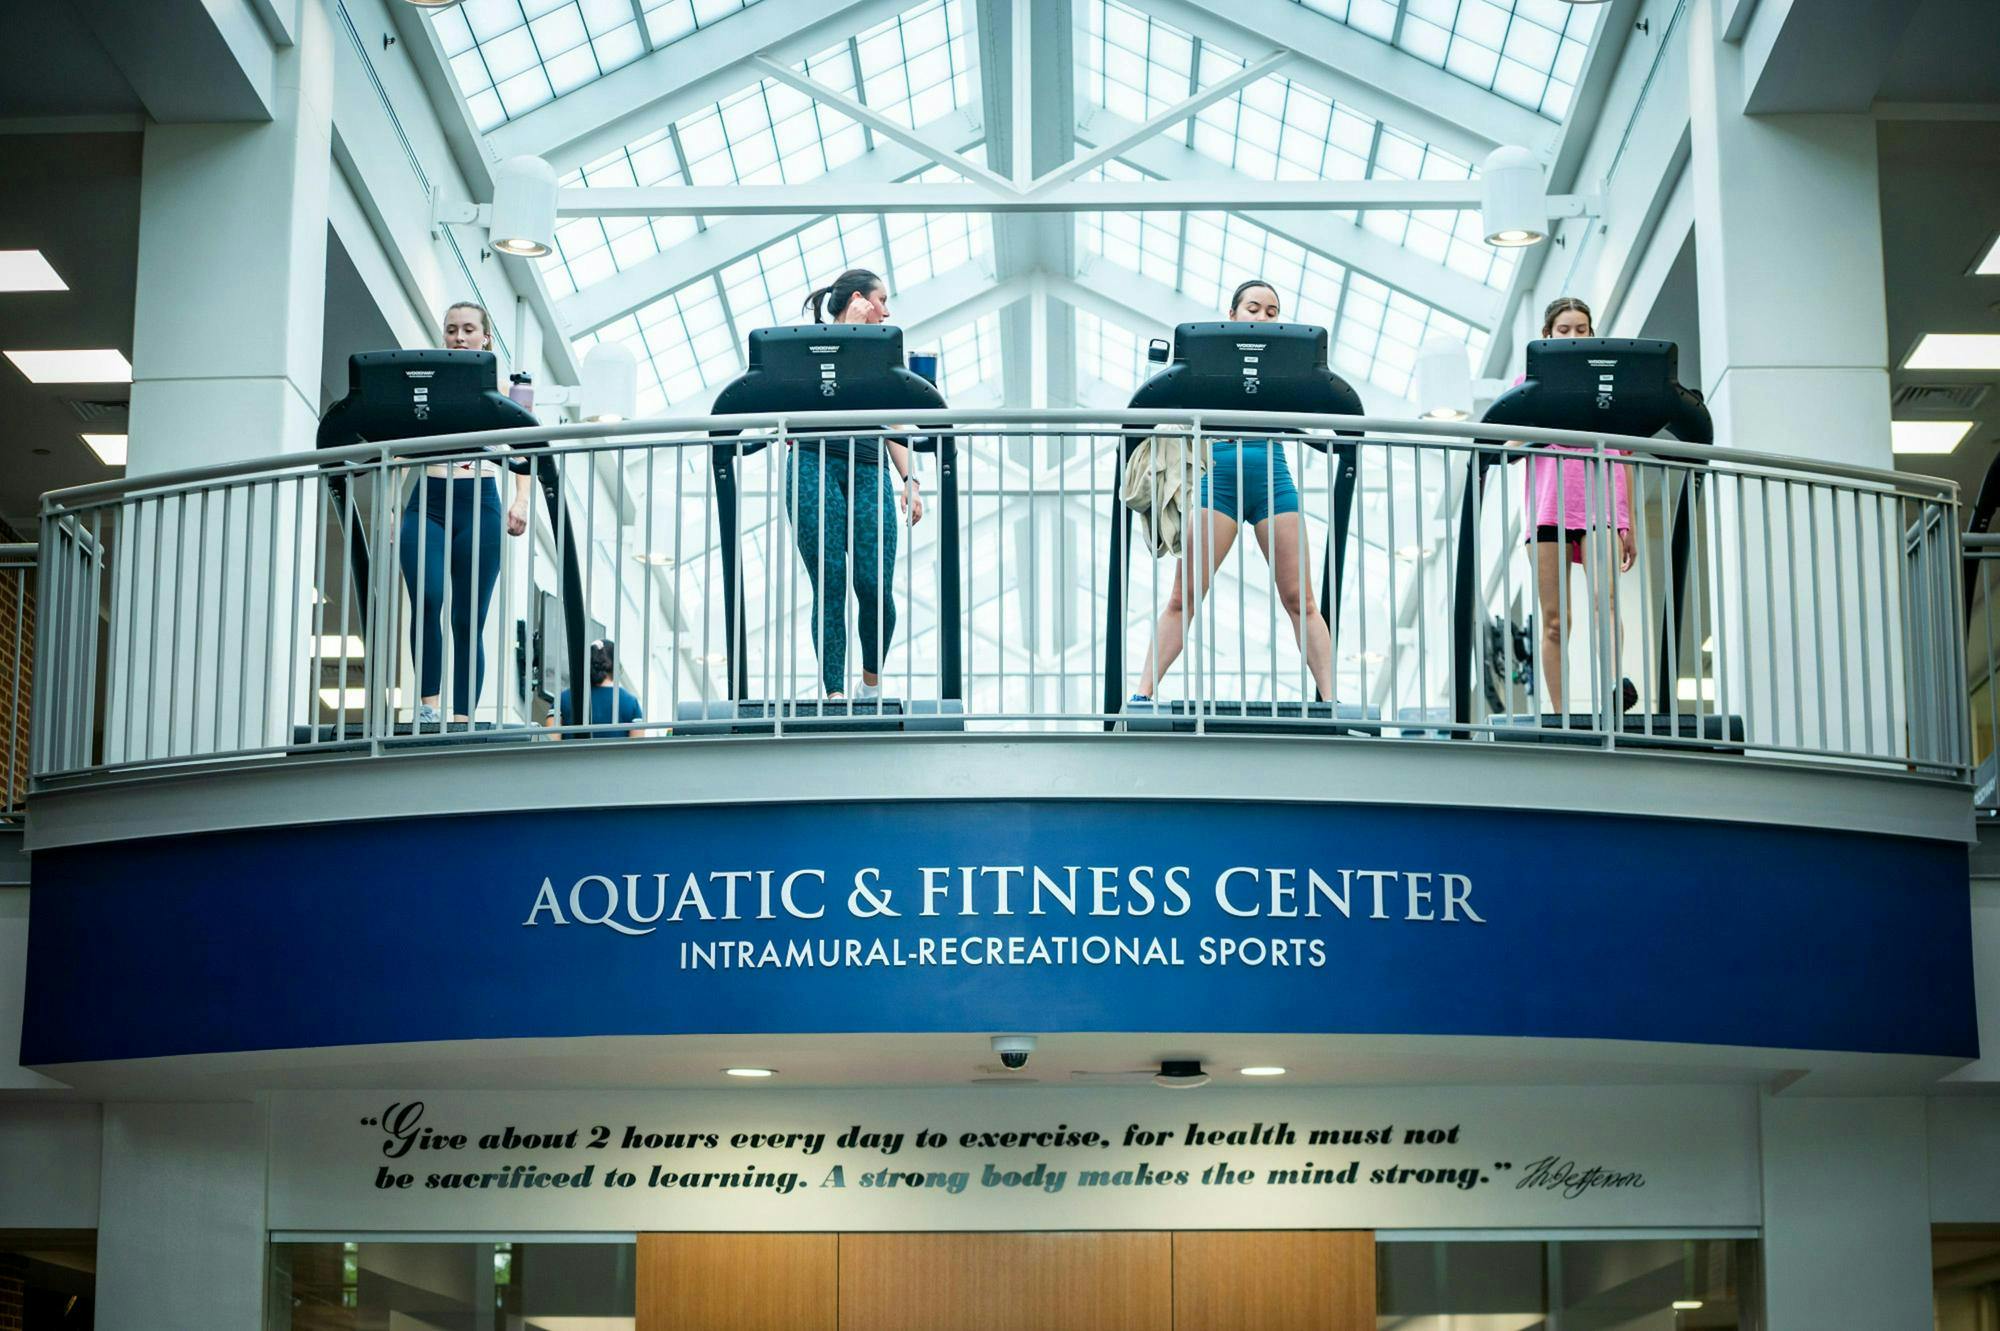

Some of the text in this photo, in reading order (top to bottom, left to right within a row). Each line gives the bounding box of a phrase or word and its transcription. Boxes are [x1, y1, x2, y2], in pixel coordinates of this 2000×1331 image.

[522, 865, 1487, 936] AQUATIC & FITNESS CENTER
[680, 935, 1327, 970] INTRAMURAL-RECREATIONAL SPORTS
[477, 1125, 579, 1150] about
[585, 1125, 611, 1150] 2
[620, 1125, 720, 1149] hours
[730, 1132, 826, 1155] every
[836, 1124, 905, 1155] day
[915, 1127, 948, 1149] to
[958, 1123, 1110, 1149] exercise,
[1122, 1122, 1175, 1147] for
[1183, 1122, 1297, 1147] health
[1308, 1124, 1395, 1146] must
[1403, 1123, 1461, 1145] not
[374, 1165, 415, 1190] be
[424, 1164, 596, 1190] sacrificed
[603, 1167, 637, 1189] to
[647, 1164, 808, 1195] learning.
[818, 1164, 847, 1188] A
[858, 1167, 970, 1194] strong
[980, 1163, 1068, 1194] body
[1077, 1161, 1190, 1187] makes
[1200, 1161, 1256, 1186] the
[1266, 1161, 1361, 1185] mind
